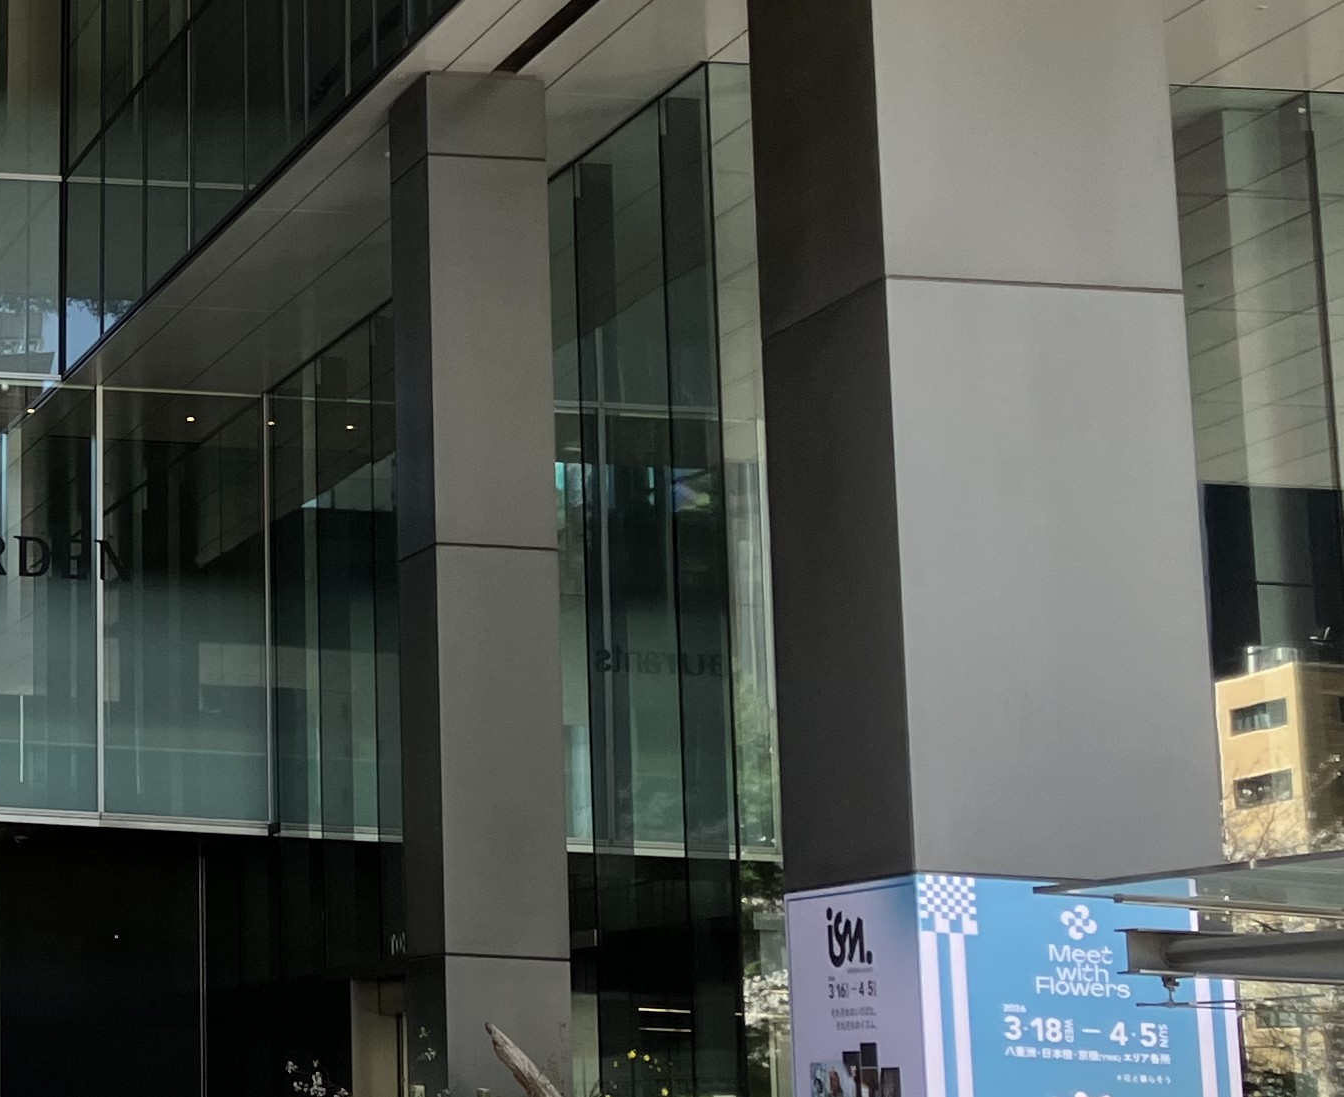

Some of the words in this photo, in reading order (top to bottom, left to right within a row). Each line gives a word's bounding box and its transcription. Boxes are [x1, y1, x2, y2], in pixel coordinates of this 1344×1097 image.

[1048, 943, 1114, 965] Meet
[1055, 963, 1110, 982] with
[1035, 975, 1131, 999] Flowers
[1002, 1003, 1026, 1013] 2026
[1063, 1018, 1075, 1043] WED
[1158, 1023, 1169, 1048] SUN
